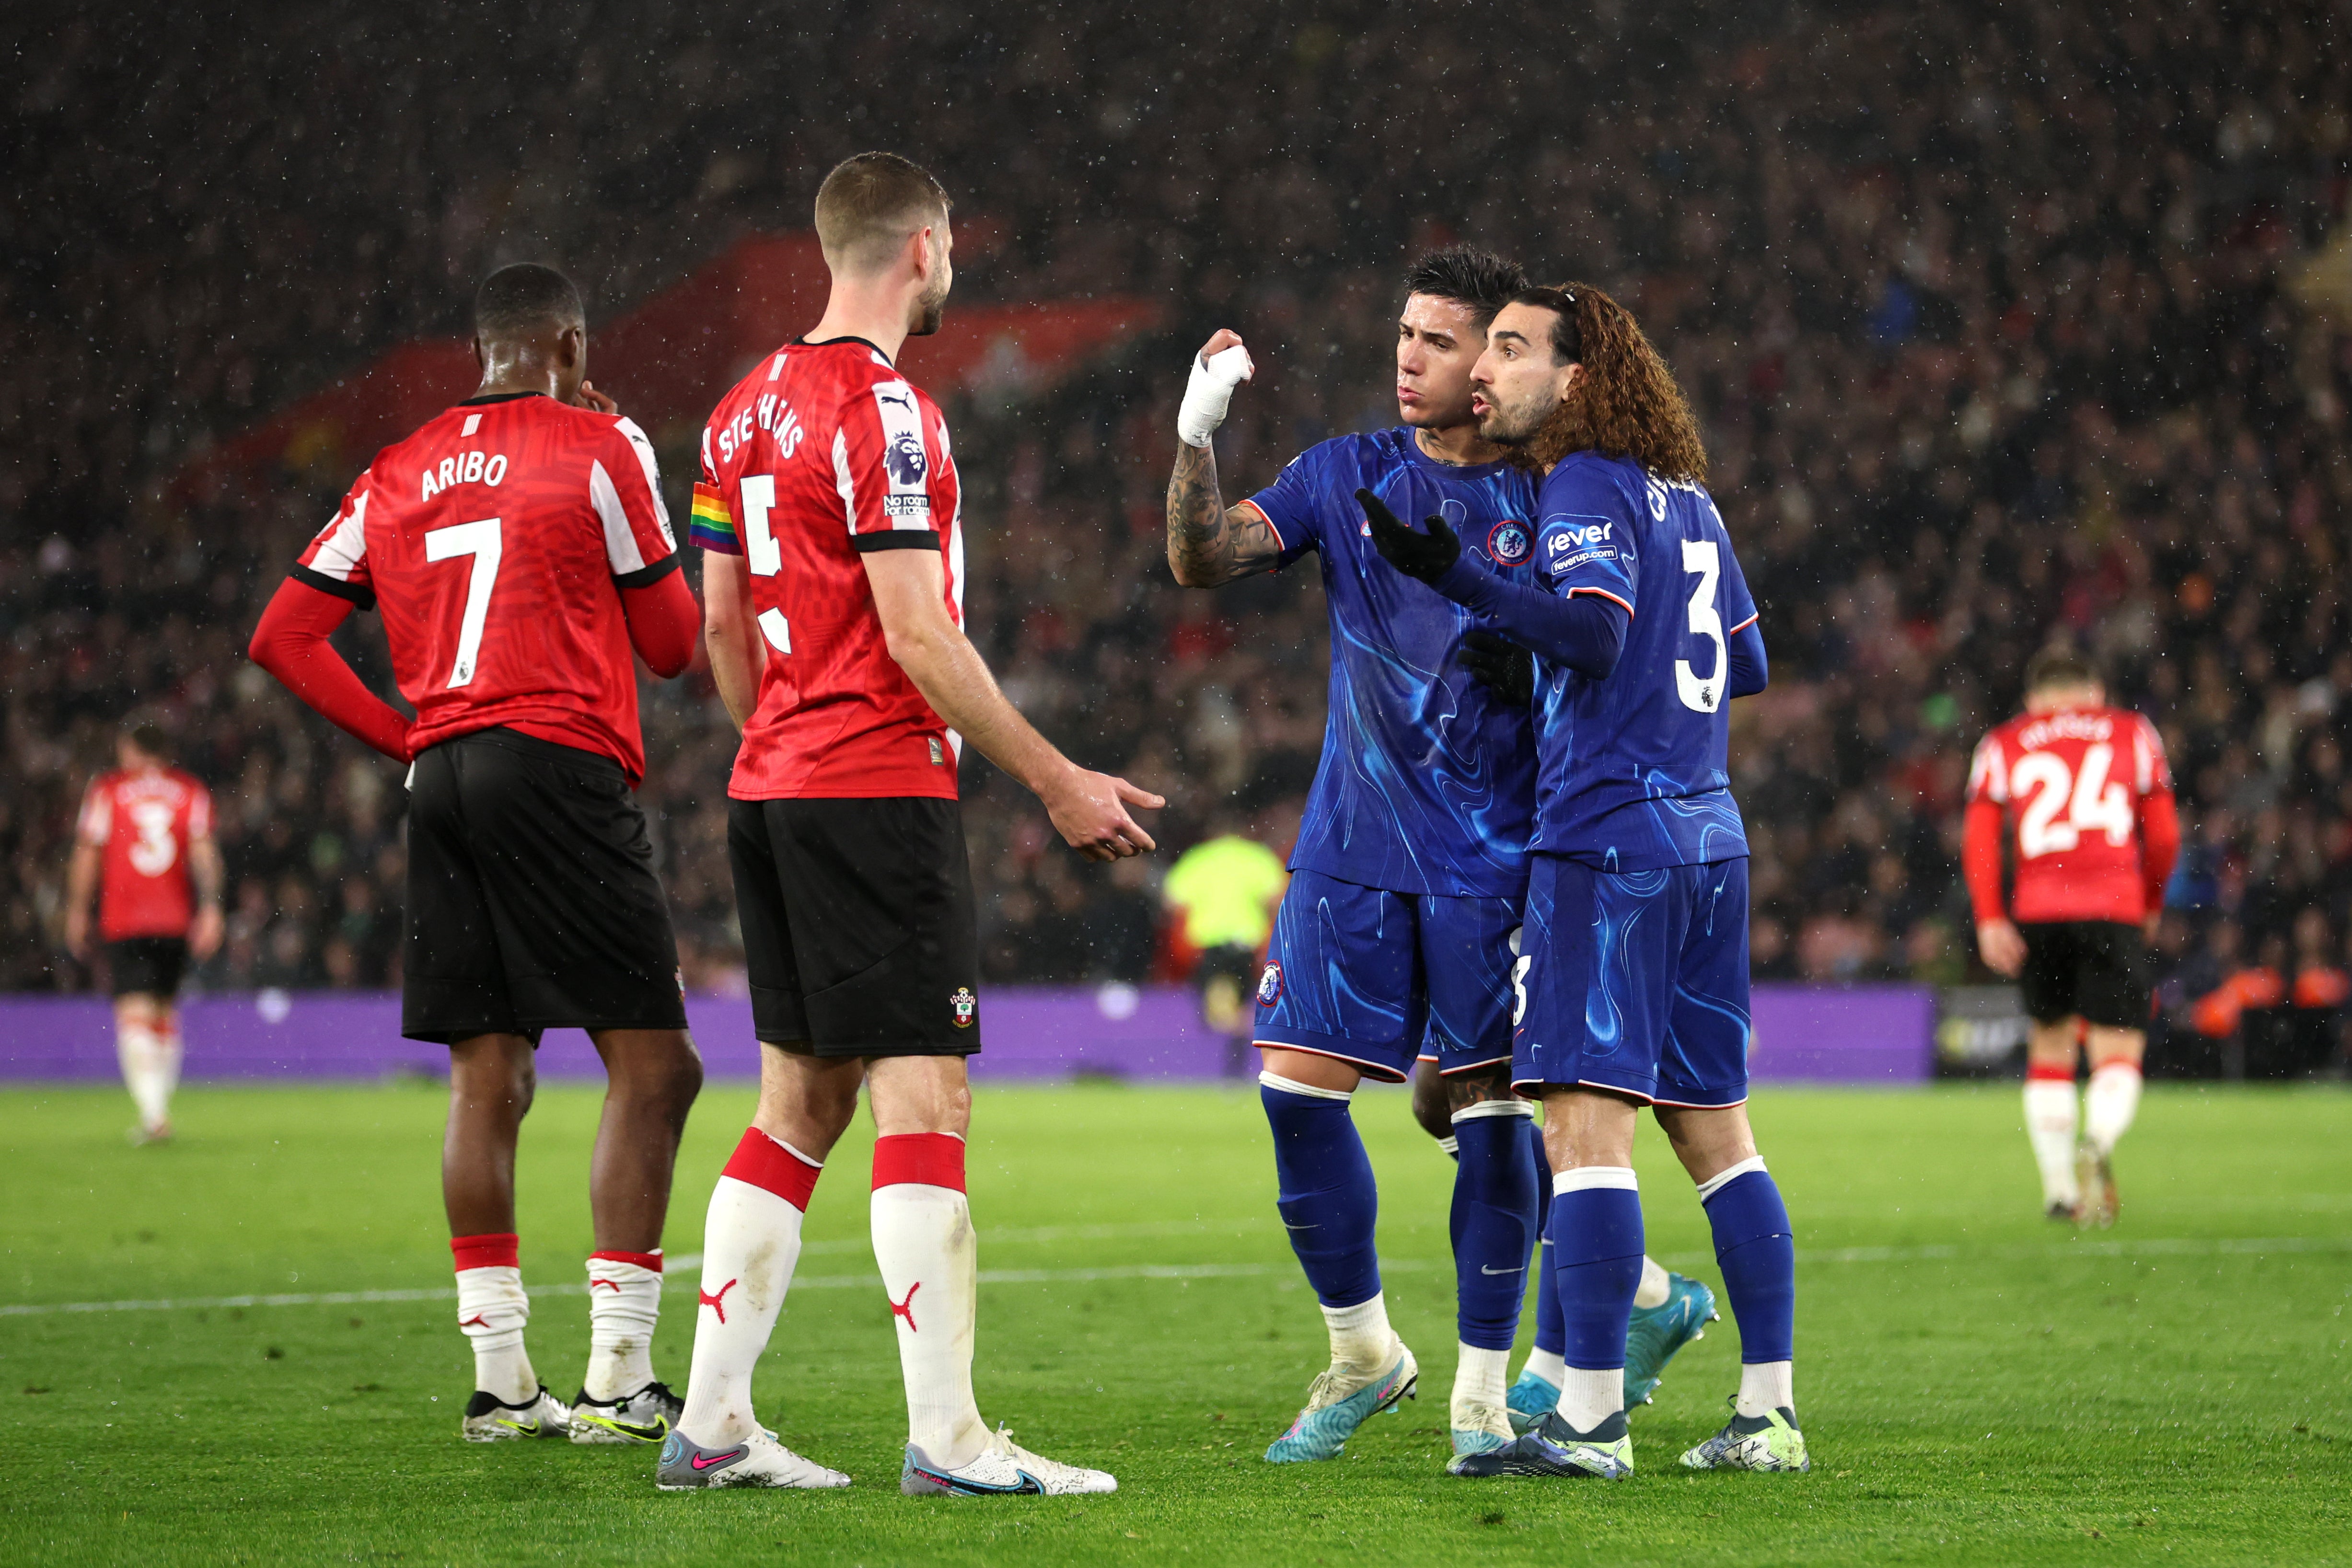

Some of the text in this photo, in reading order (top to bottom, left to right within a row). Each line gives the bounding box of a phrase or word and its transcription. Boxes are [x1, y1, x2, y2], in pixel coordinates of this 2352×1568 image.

[128, 322, 178, 398] 3
[718, 394, 804, 463] STEHENS
[422, 451, 508, 502] ARIBO
[883, 495, 927, 507] No room
[884, 506, 902, 516] for
[1548, 522, 1612, 558] fever
[1554, 550, 1614, 571] feverup.com
[425, 517, 503, 689] 7
[1675, 538, 1728, 714] 3
[2010, 742, 2134, 860] 24
[1513, 955, 1531, 1026] 3
